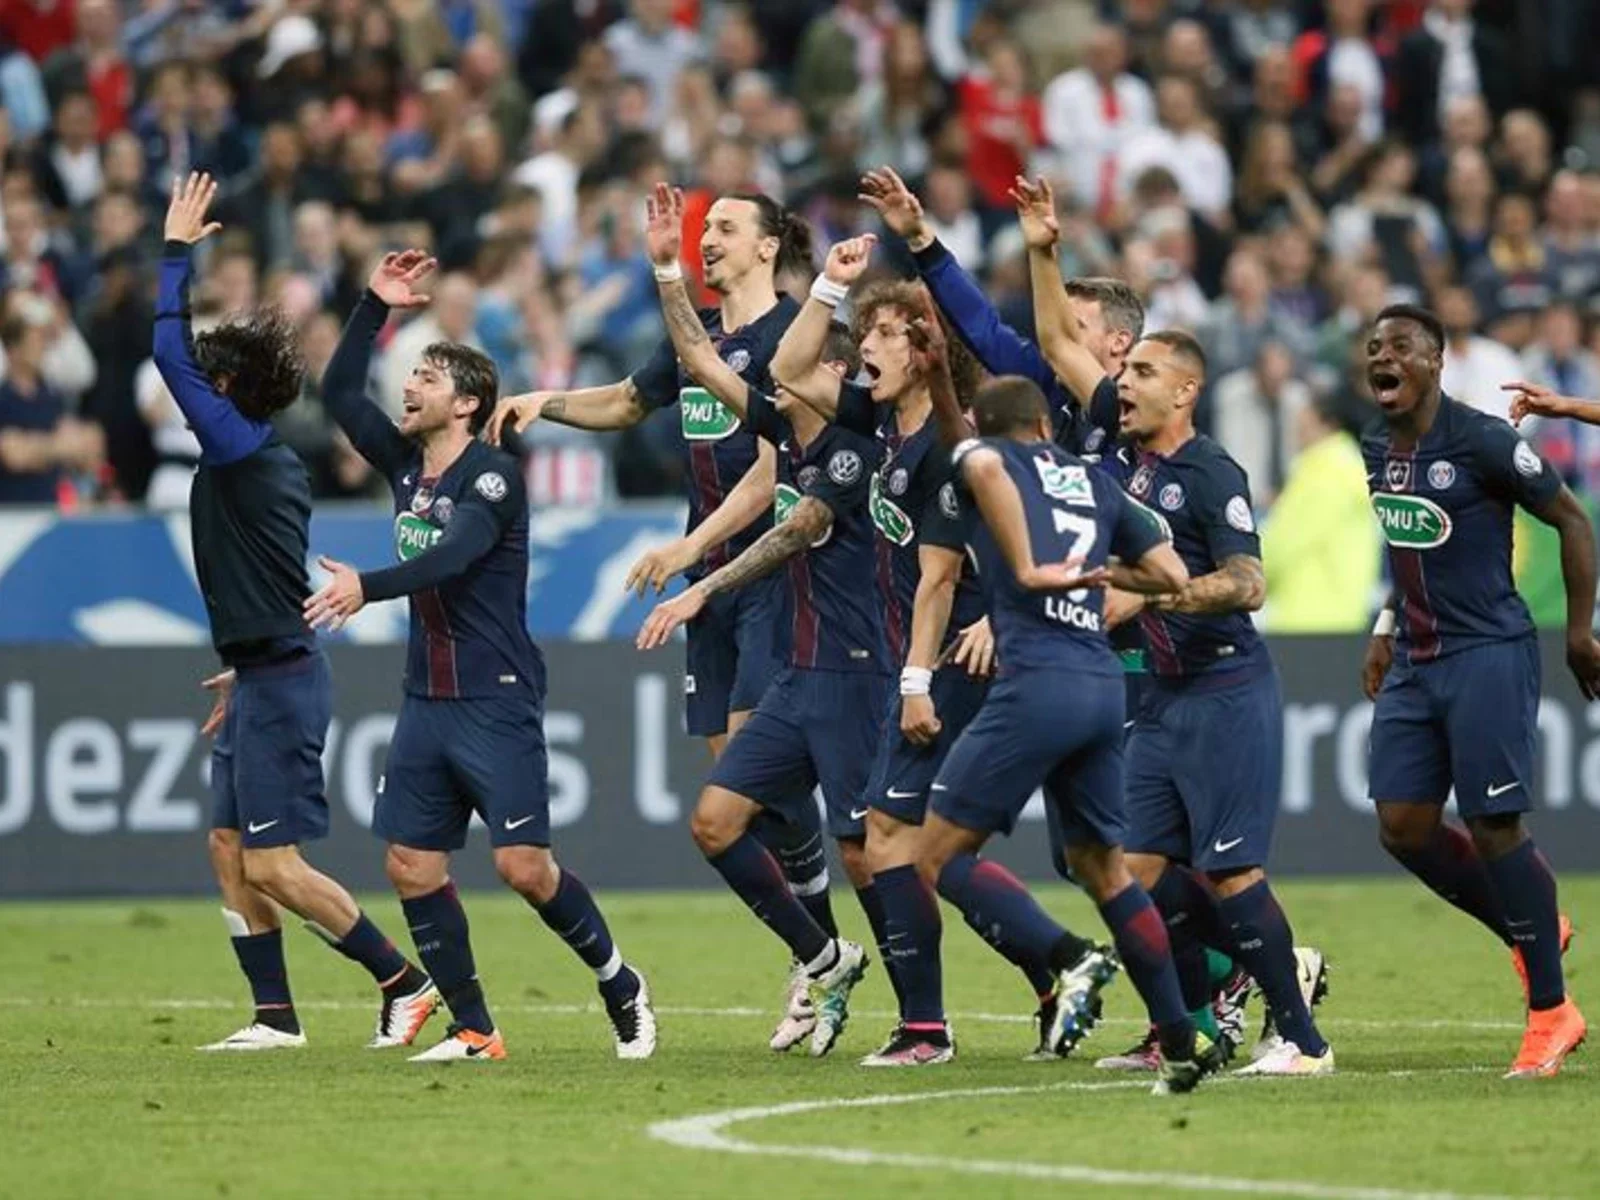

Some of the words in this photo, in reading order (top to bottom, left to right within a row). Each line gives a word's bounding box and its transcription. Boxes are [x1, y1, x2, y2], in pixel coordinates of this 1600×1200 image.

[682, 402, 713, 422] PMU
[1051, 507, 1097, 602] 7
[1045, 595, 1100, 632] LUCAS
